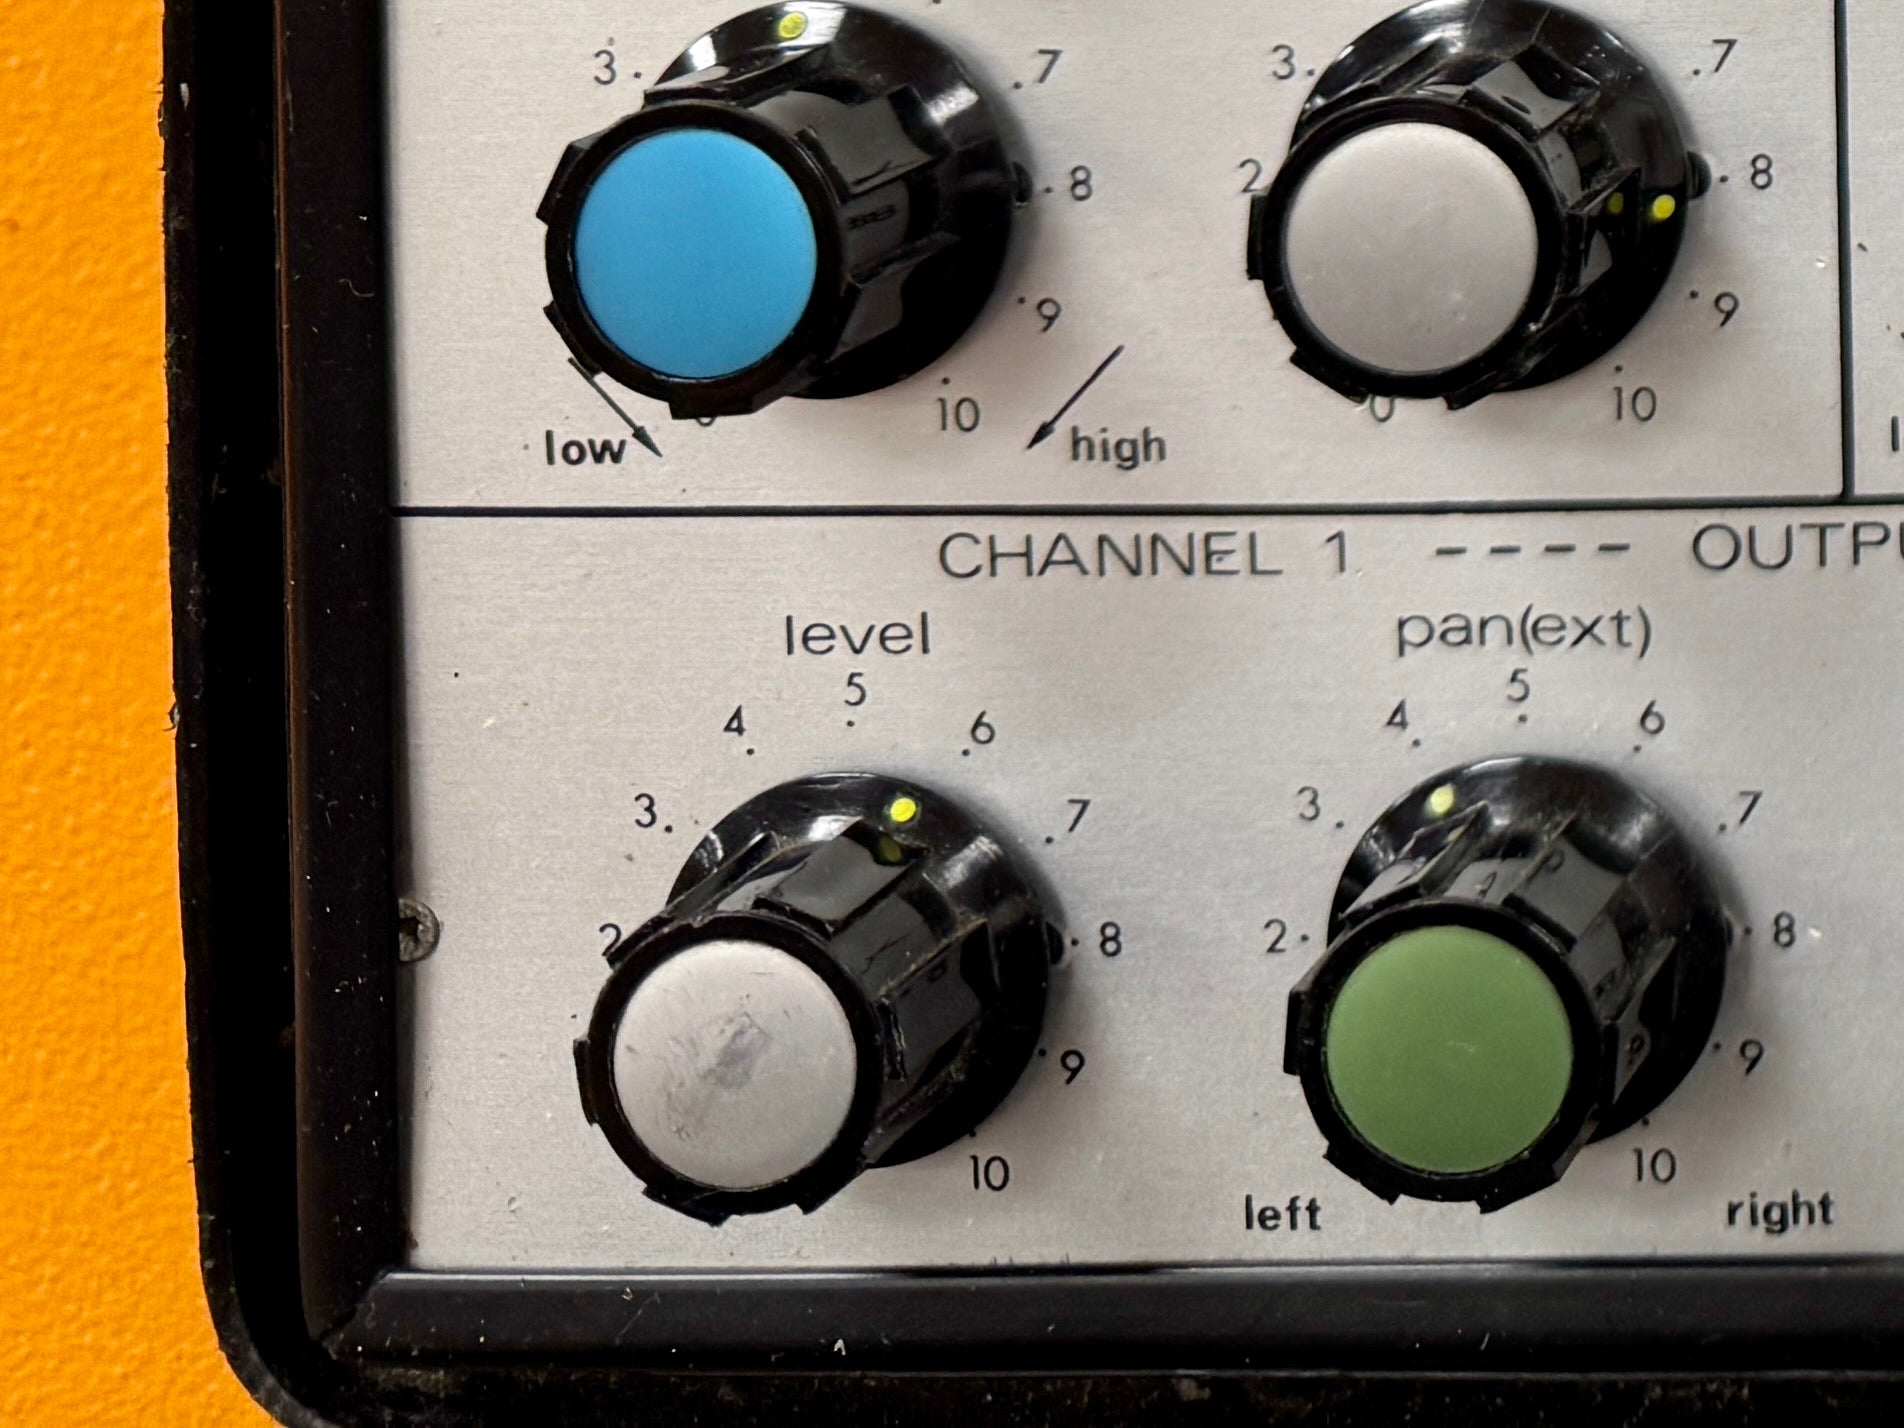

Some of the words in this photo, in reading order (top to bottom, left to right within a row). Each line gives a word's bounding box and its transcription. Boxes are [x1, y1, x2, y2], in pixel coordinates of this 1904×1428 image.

[545, 430, 627, 466] low
[1069, 421, 1166, 470] high
[939, 531, 1283, 579] CHANNEL
[1325, 531, 1346, 573] 1
[786, 611, 930, 656] level
[1397, 604, 1651, 660] pan(ext)
[1245, 1194, 1321, 1231] left
[1727, 1189, 1833, 1237] right
